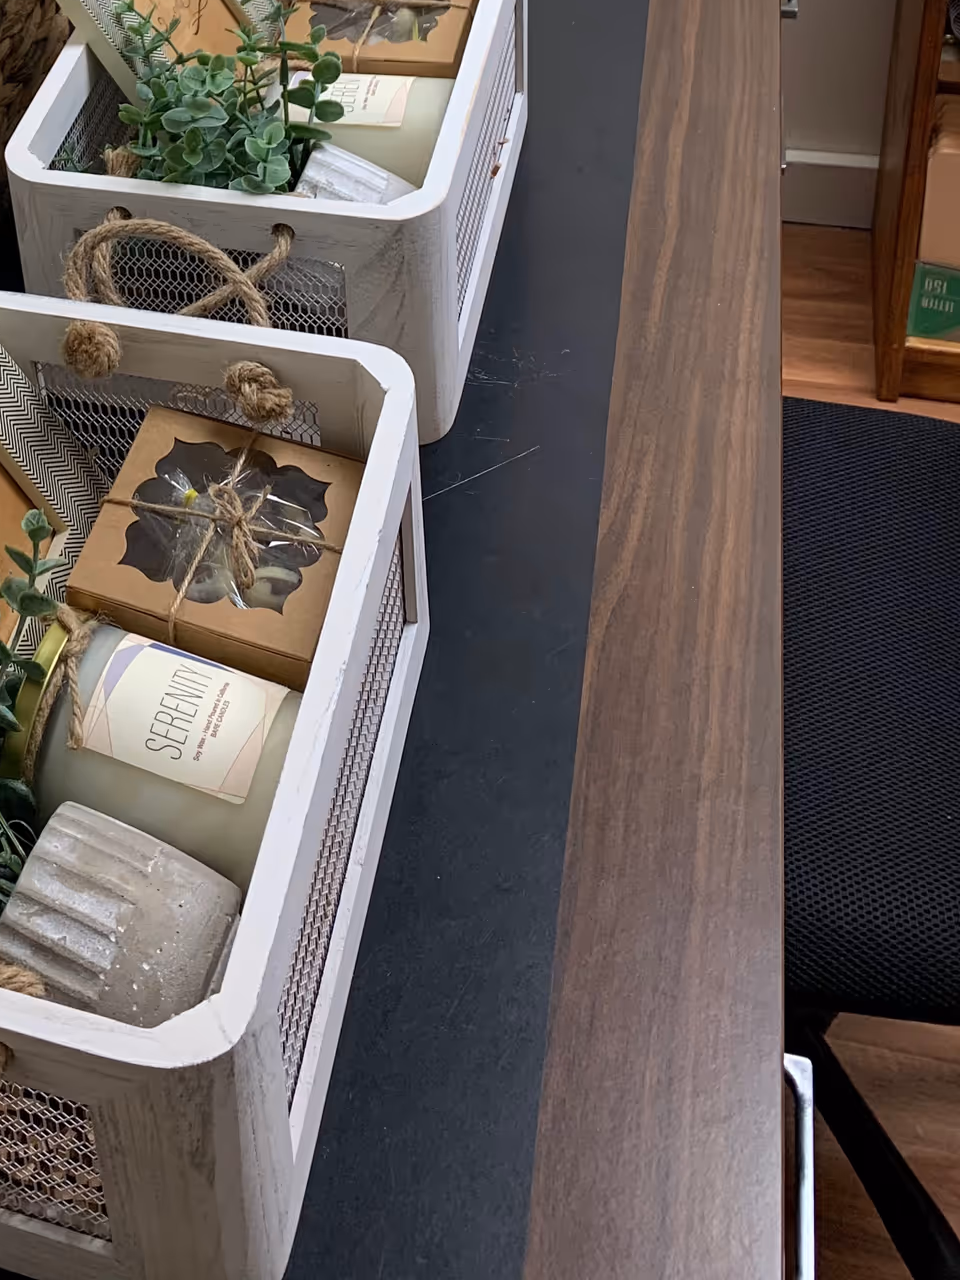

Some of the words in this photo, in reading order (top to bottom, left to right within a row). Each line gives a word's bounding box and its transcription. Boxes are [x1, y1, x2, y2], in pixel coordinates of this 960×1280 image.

[145, 663, 213, 761] SERENITY
[210, 723, 221, 739] BARE
[216, 700, 230, 724] CANDLES
